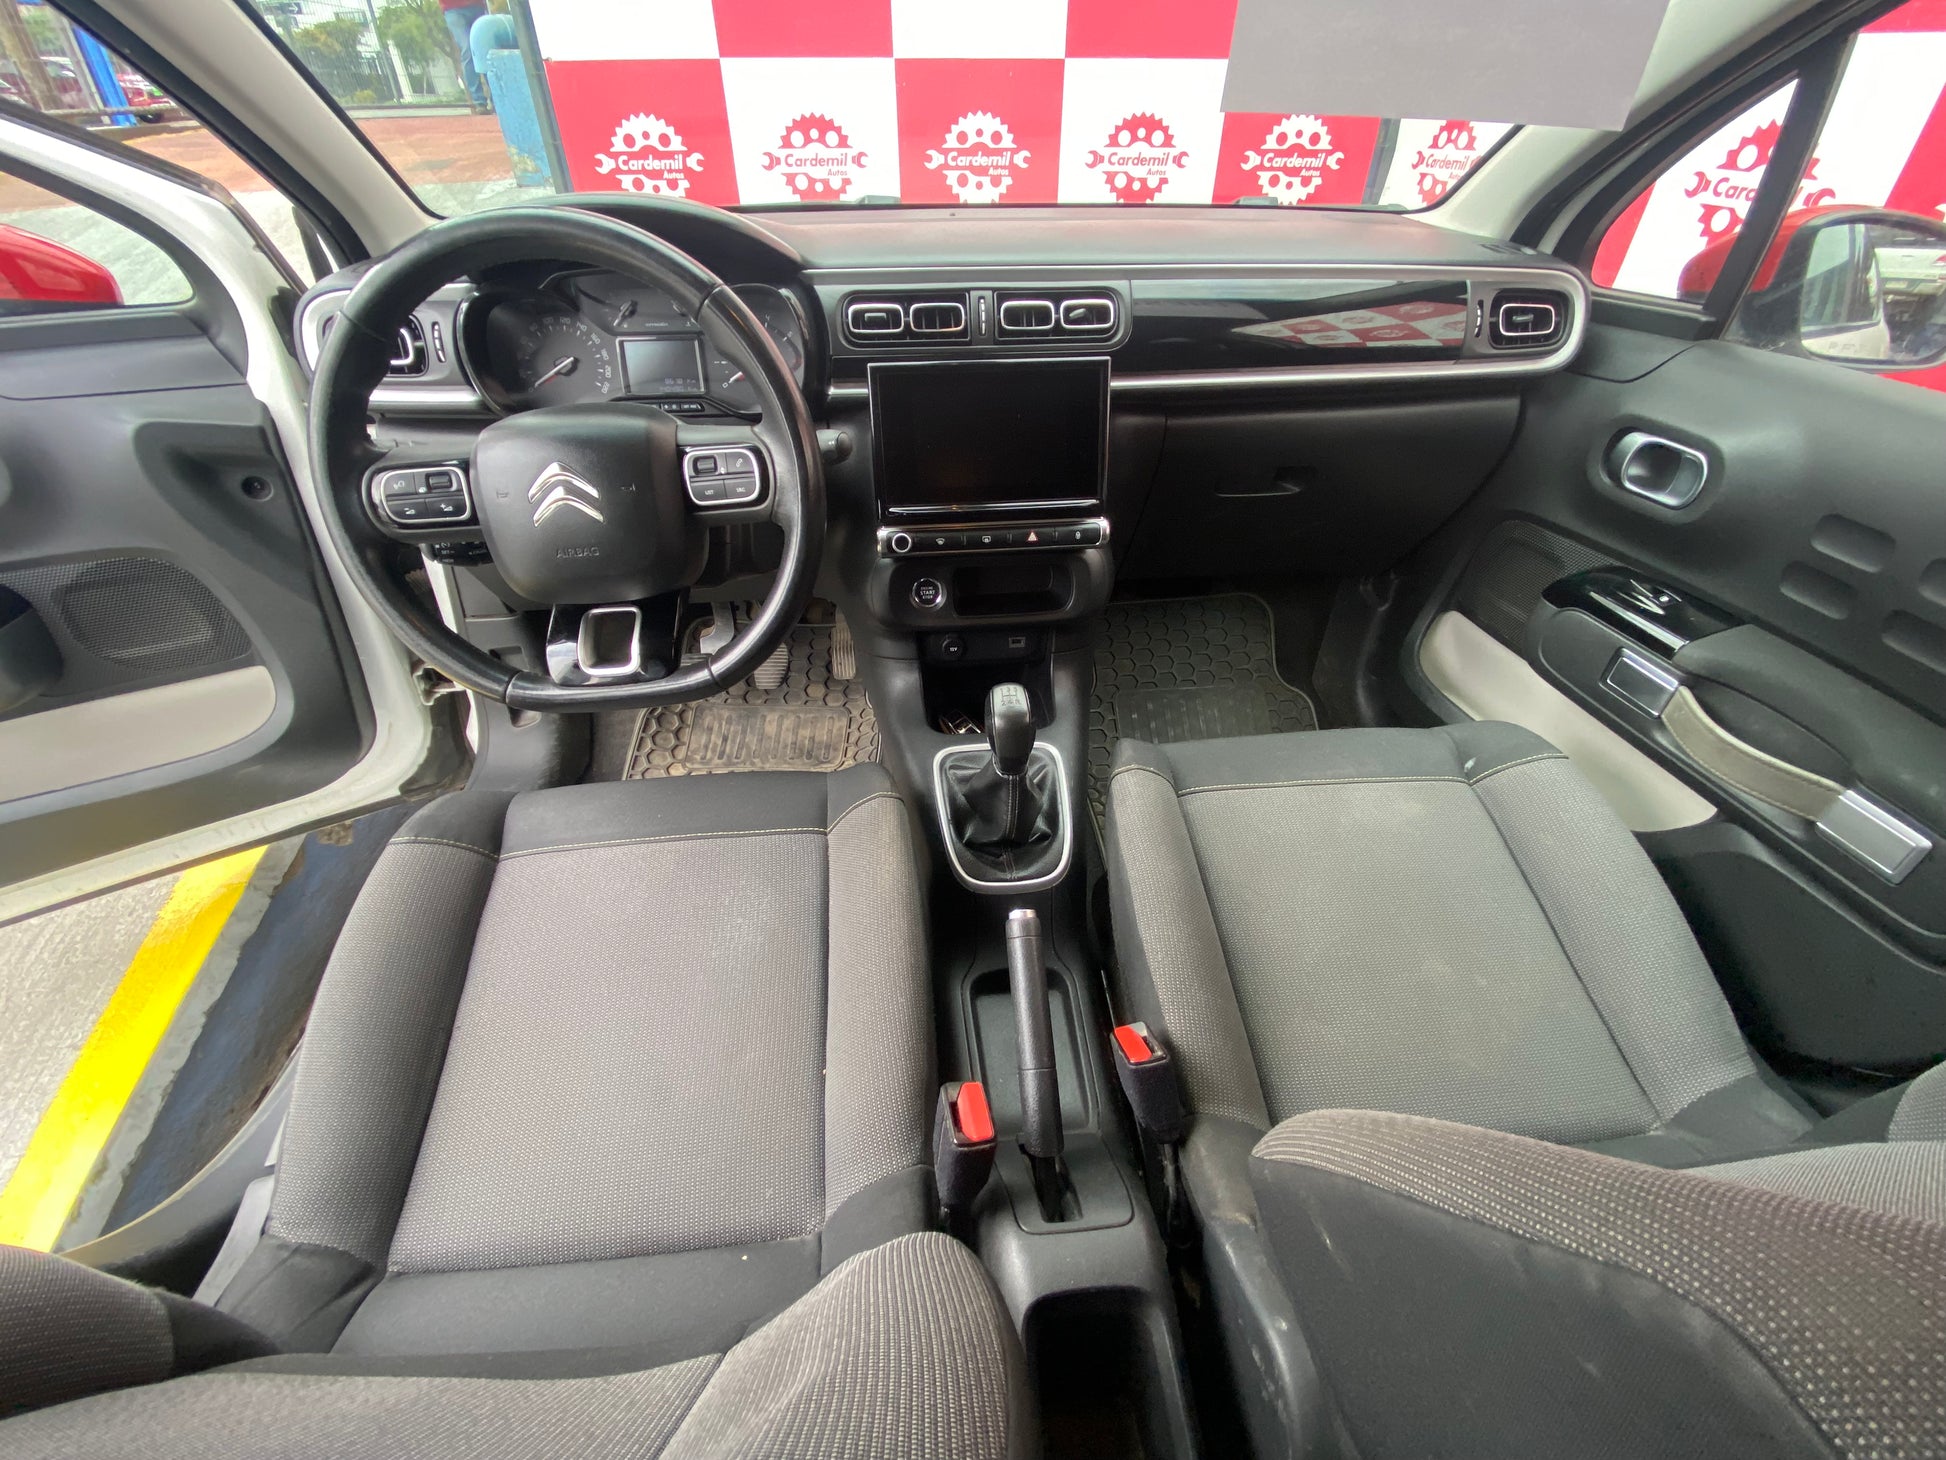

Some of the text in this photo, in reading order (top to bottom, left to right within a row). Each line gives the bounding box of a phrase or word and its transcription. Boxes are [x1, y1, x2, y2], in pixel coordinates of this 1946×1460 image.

[618, 154, 683, 170] Cardemil
[785, 153, 848, 167] Cardemil
[947, 151, 1011, 166] Cardemil
[1108, 152, 1170, 166] Cardemil
[1263, 153, 1326, 168] Cardemil
[1426, 154, 1470, 171] Cardemil
[663, 170, 684, 179] Autos
[988, 167, 1009, 175] Autos
[1145, 168, 1166, 176] Autos
[1300, 169, 1320, 177] Autos
[576, 321, 587, 331] 140
[590, 333, 600, 344] 160
[601, 381, 610, 394] 220
[556, 546, 600, 559] AIRBAG
